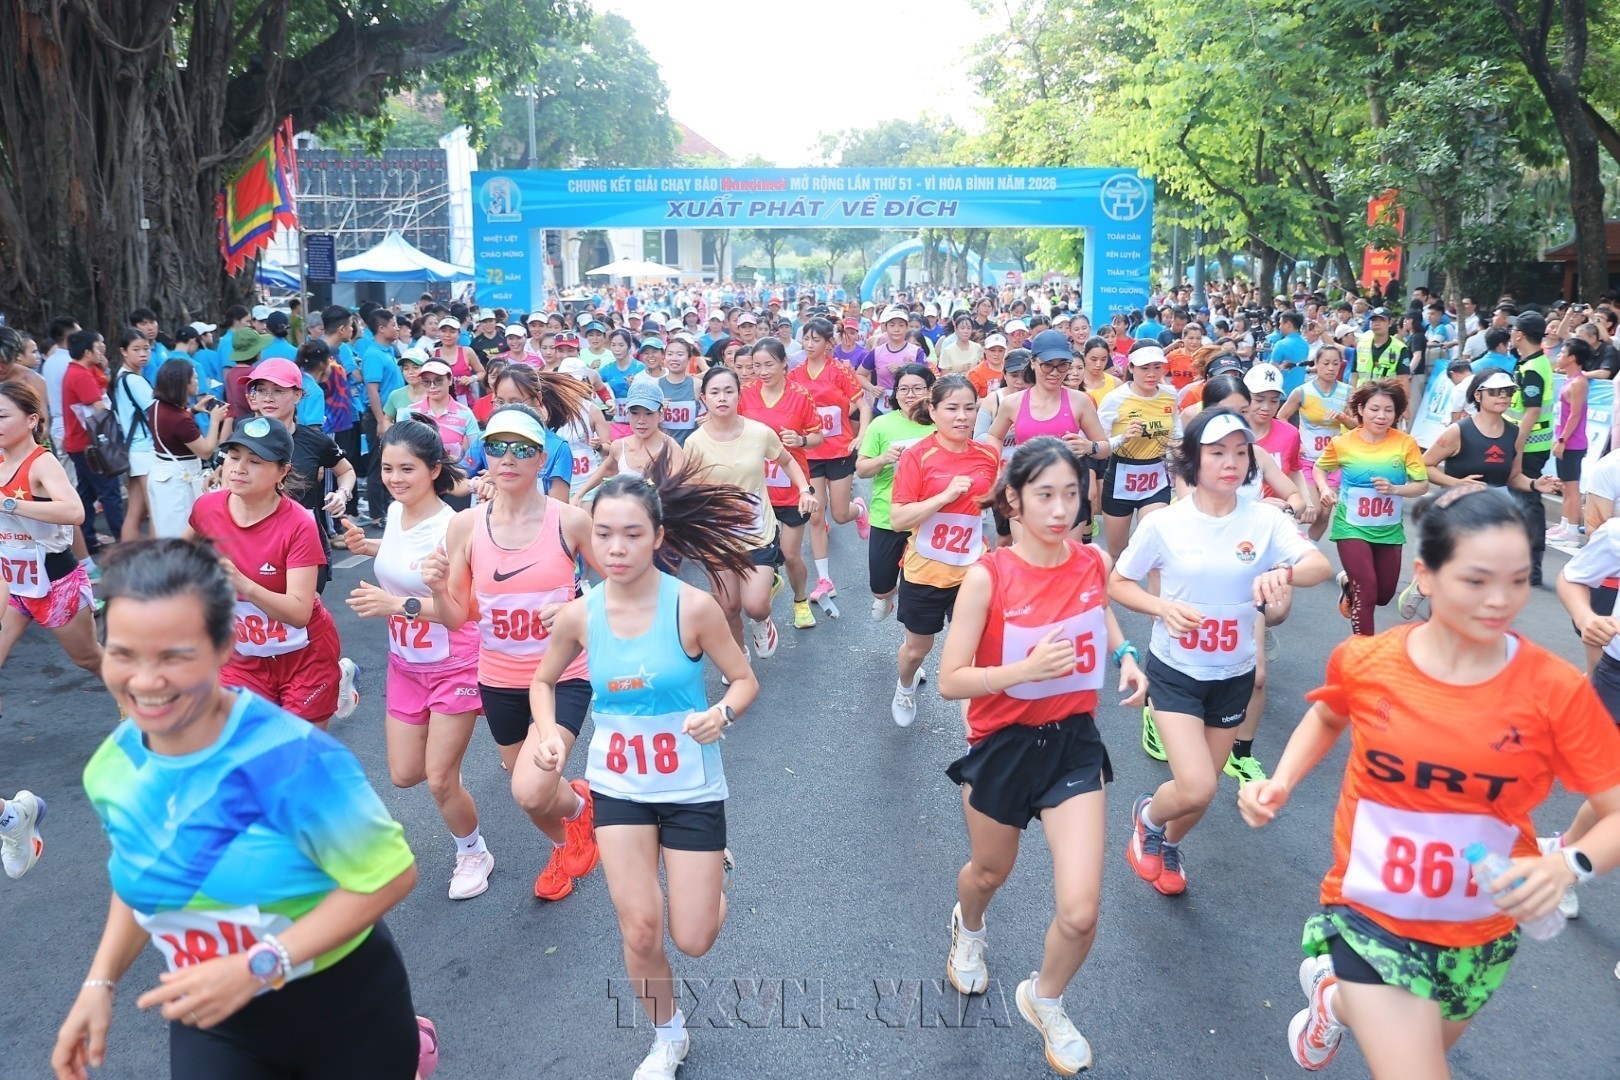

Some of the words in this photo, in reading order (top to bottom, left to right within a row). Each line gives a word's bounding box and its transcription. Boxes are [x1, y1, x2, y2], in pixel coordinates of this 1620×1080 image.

[567, 179, 607, 192] CHUNG
[610, 175, 631, 192] KẾT
[634, 175, 658, 192] GIẢI
[661, 178, 690, 195] CHẠY
[694, 175, 717, 191] BÁO
[790, 175, 809, 191] MỞ
[812, 175, 844, 193] RỘNG
[874, 175, 896, 191] THỨ
[899, 177, 913, 191] 51
[925, 175, 936, 190] VÌ
[939, 176, 963, 190] HÒA
[966, 175, 993, 190] BÌNH
[997, 174, 1026, 190] NĂM
[1028, 177, 1057, 190] 2026
[664, 194, 743, 219] XUẤT
[884, 196, 959, 217] ĐÍCH
[664, 408, 690, 423] 630
[1125, 472, 1159, 492] 520
[1358, 497, 1394, 517] 804
[931, 523, 973, 554] 822
[606, 732, 679, 775] 818
[1365, 749, 1519, 802] SRT
